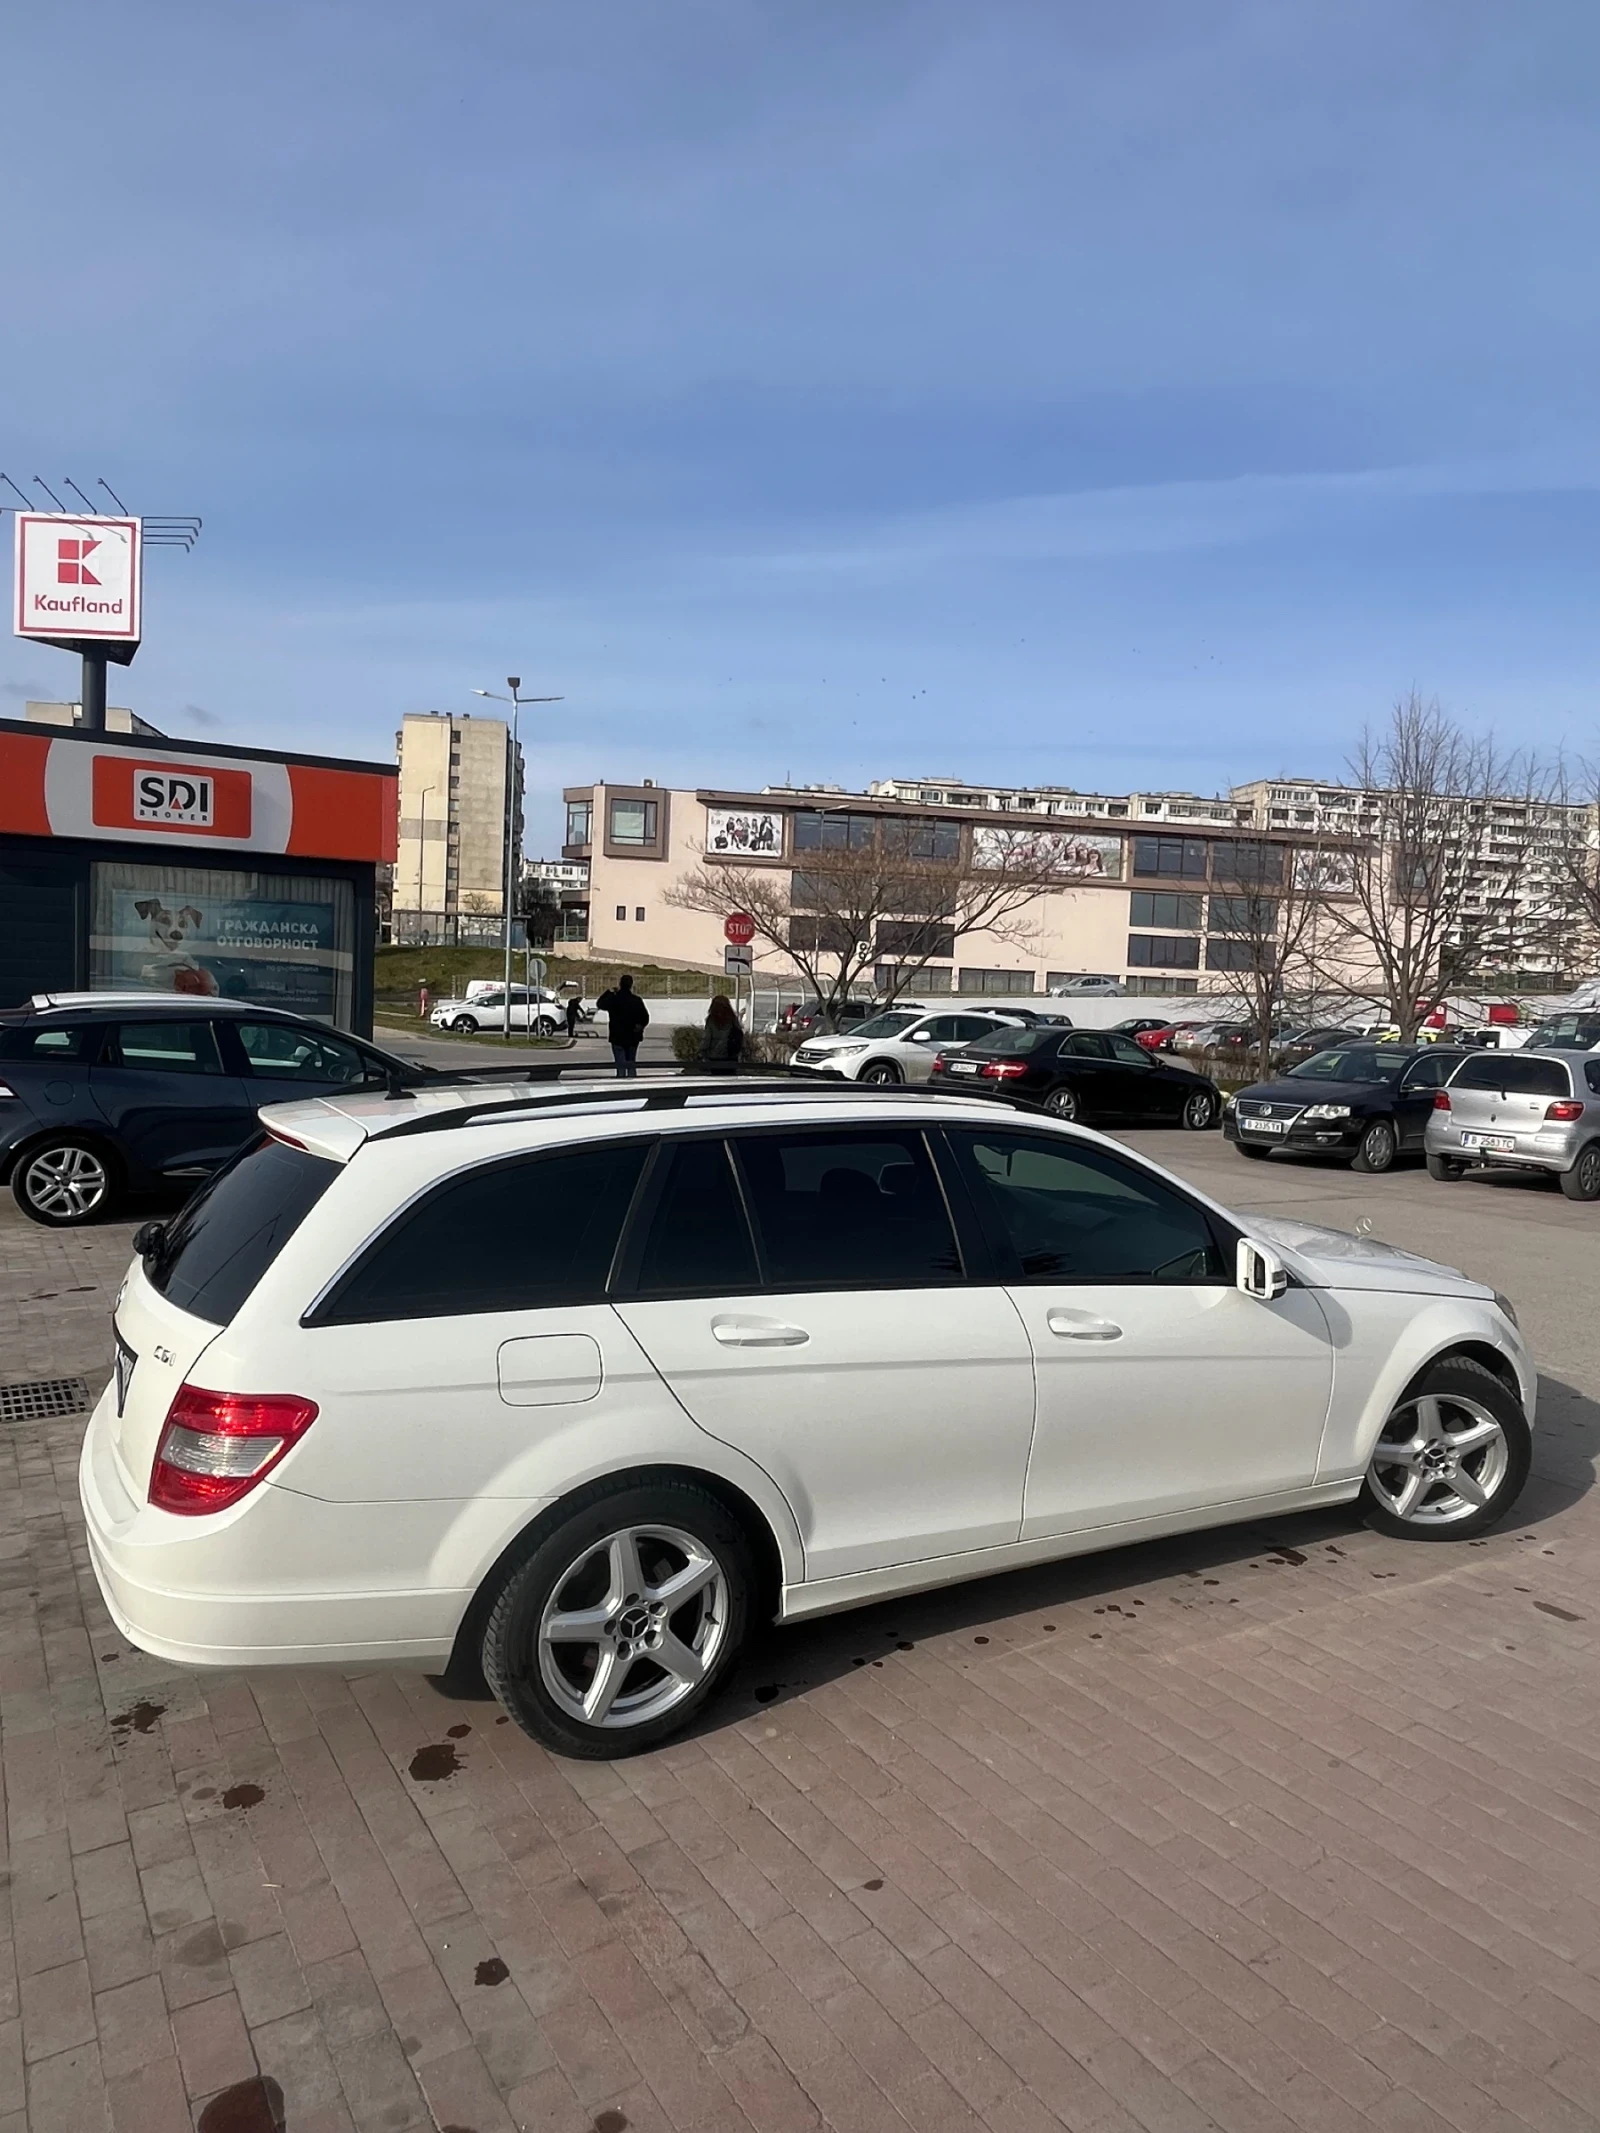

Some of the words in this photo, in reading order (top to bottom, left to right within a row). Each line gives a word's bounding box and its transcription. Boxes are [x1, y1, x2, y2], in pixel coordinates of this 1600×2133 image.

[34, 594, 123, 614] Kaufland
[140, 776, 208, 812] SDI
[139, 809, 208, 821] BROKER
[217, 919, 318, 934] ГРАЖДАНСКА
[728, 923, 752, 935] STOP
[217, 936, 318, 950] ОТГОВОРНОСТ
